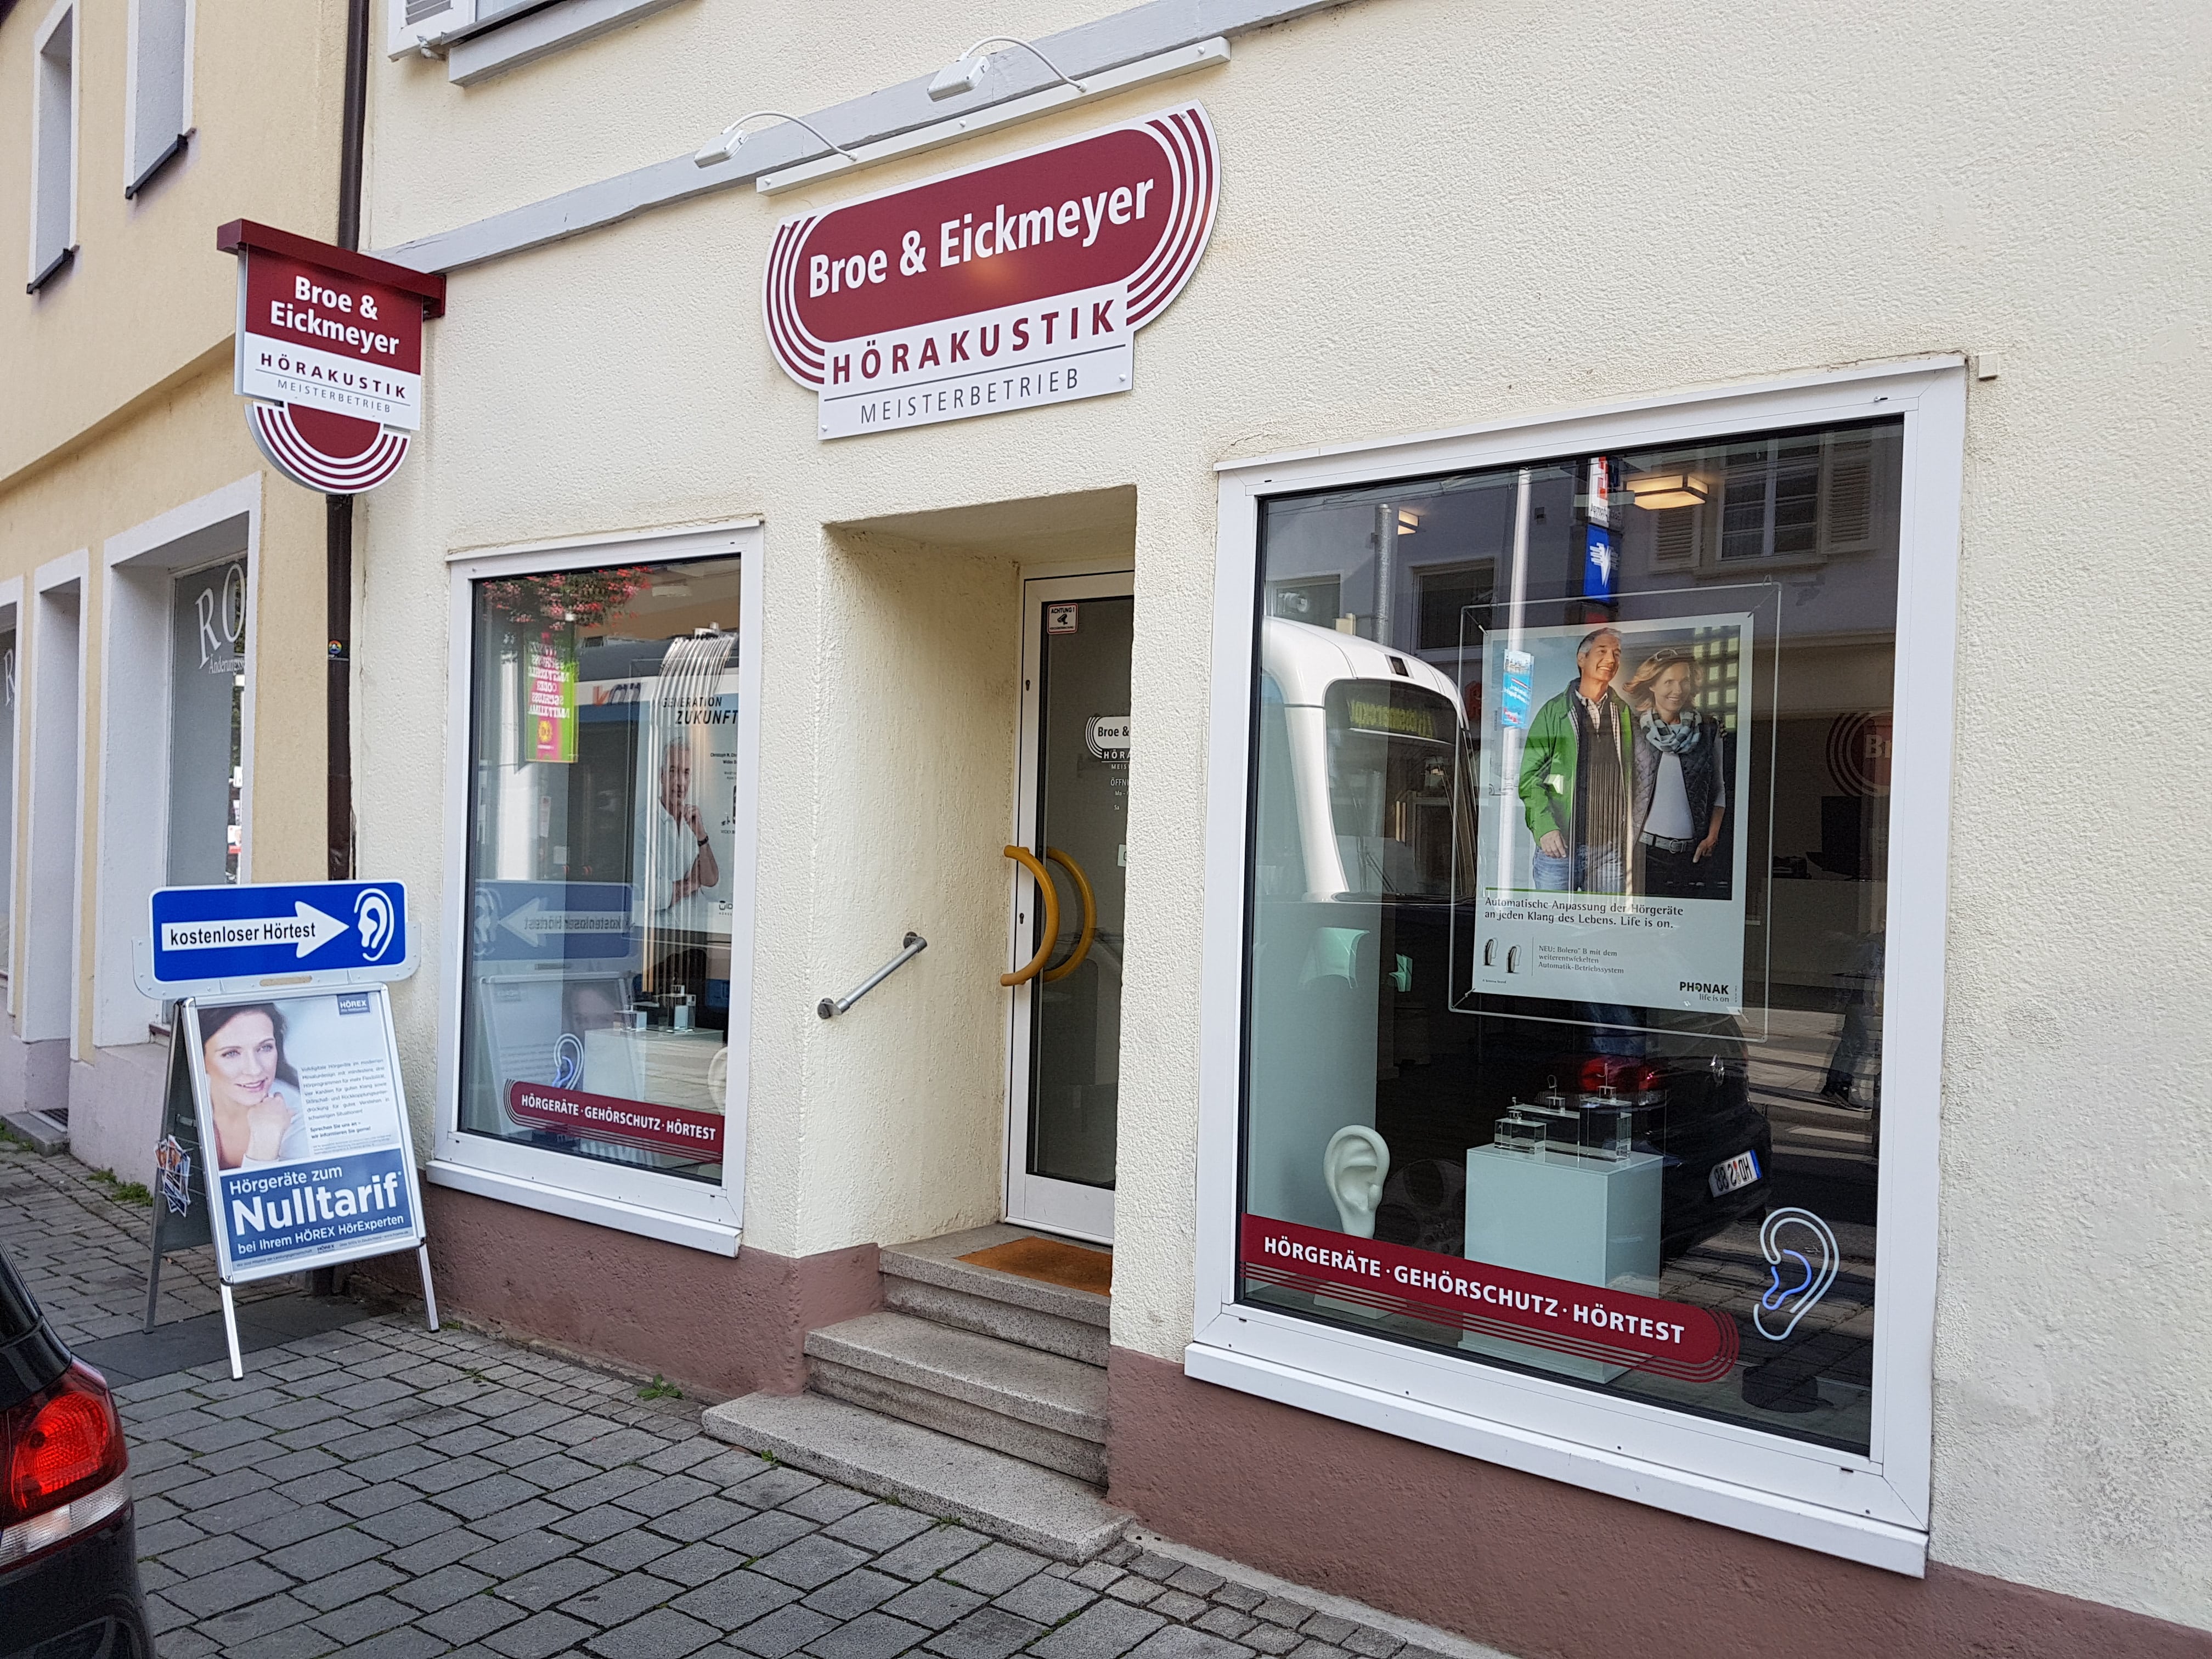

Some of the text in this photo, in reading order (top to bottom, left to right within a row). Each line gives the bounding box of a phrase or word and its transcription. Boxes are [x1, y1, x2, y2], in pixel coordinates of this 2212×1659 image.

[810, 178, 1154, 298] Broe & Eickmeyer
[295, 275, 378, 320] Broe &
[270, 301, 399, 355] Eickmeyer
[833, 299, 1115, 385] HÖRAKUSTIK
[261, 352, 405, 398] HÖRAKUSTIK
[278, 379, 390, 413] MEISTERBETRIEB
[861, 368, 1079, 424] MEISTERBETRIEB
[195, 563, 245, 669] RO
[675, 710, 738, 724] ZUKUNFT
[1098, 726, 1129, 737] Broe &
[1485, 897, 1684, 917] Automatische Anpassung der Hörgeräte
[1497, 910, 1523, 921] jeden
[1527, 911, 1554, 923] Klang
[1558, 913, 1574, 923] des
[1579, 915, 1616, 925] Lebens.
[1621, 916, 1640, 926] Life
[1645, 918, 1652, 927] is
[171, 922, 315, 946] kostenloser Hörtest
[1538, 962, 1624, 974] Automatik-Betriebssystem
[1539, 954, 1599, 963] weiterentwickelten
[340, 1000, 366, 1009] HÖREX
[1680, 981, 1729, 995] PHONAK
[521, 1092, 715, 1141] HÖRGERÄTE GEHÖRSCHUTZ HÖRTEST
[230, 1165, 342, 1195] Hörgeräte zum
[232, 1172, 398, 1236] Nulltarif
[238, 1241, 256, 1255] bei
[259, 1236, 292, 1250] Ihrem
[295, 1226, 335, 1244] HÖREX
[338, 1214, 404, 1235] HörExperten
[1264, 1235, 1685, 1344] HÖRGERÄTE GEHÖRSCHUTZ HÖRTEST
